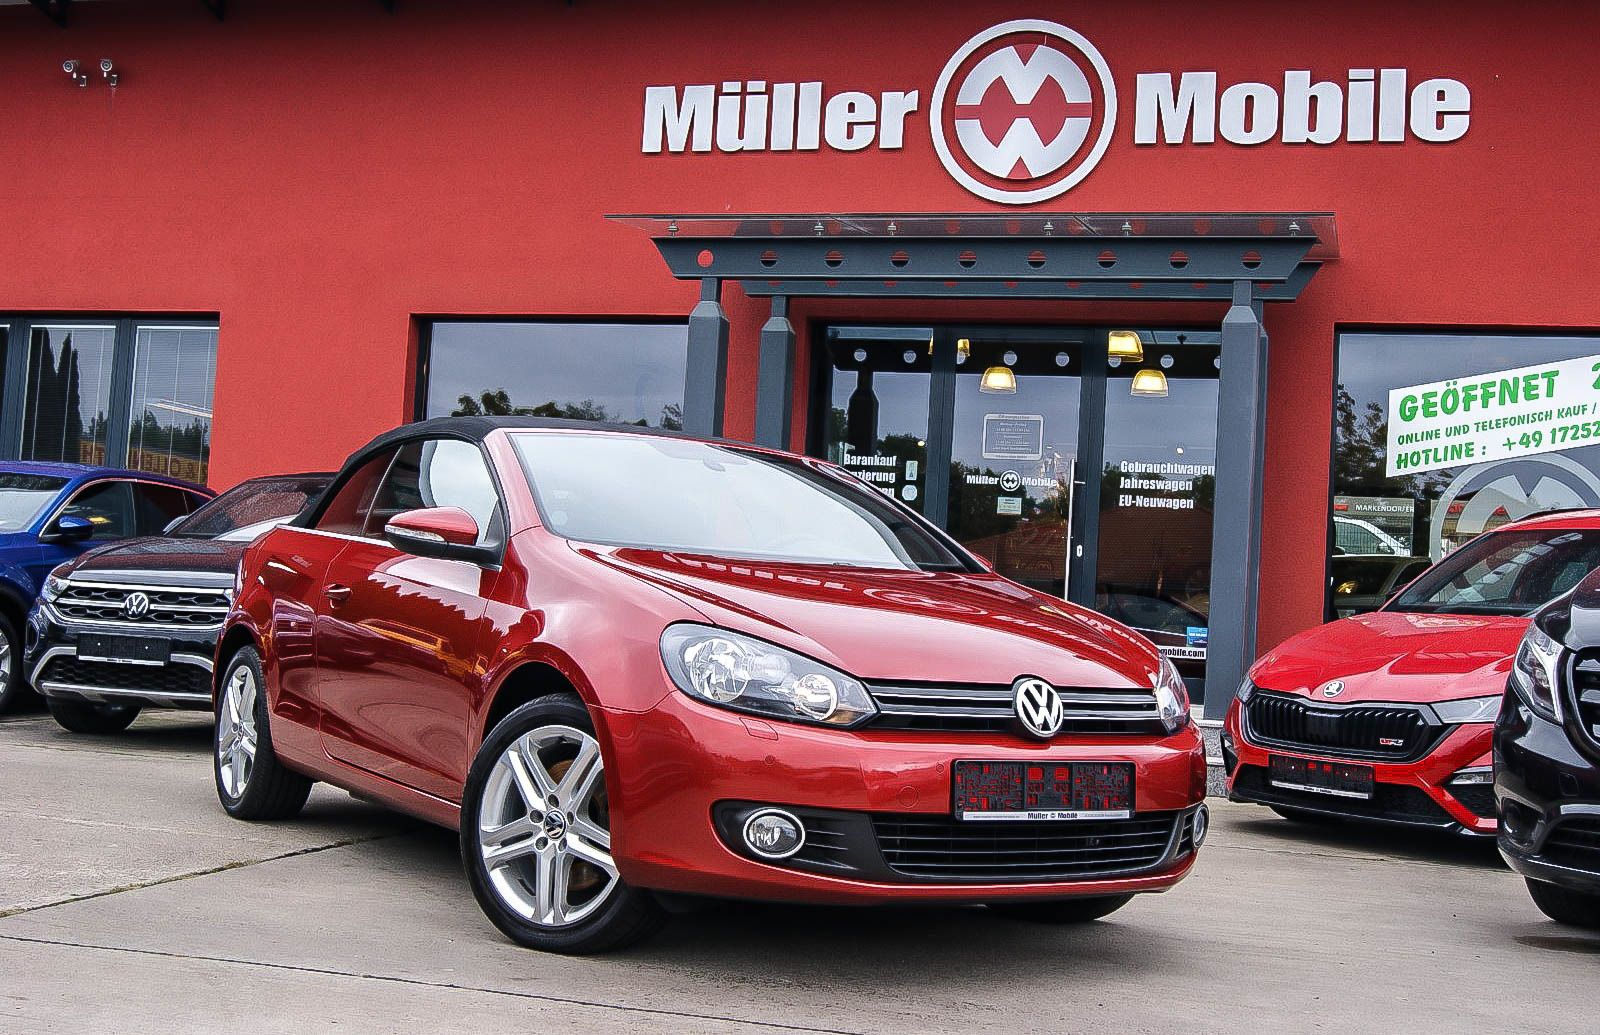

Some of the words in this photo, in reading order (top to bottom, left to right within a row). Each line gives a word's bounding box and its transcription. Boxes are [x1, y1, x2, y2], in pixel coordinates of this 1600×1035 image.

[642, 80, 919, 153] Müller
[1134, 68, 1472, 145] Mobile
[1399, 370, 1559, 422] GEÖFFNET
[1397, 428, 1441, 446] ONLINE
[1445, 424, 1470, 438] UND
[1474, 410, 1553, 433] TELEFONISCH
[1557, 404, 1588, 419] KAUF
[1396, 442, 1475, 470] HOTLINE
[1502, 430, 1543, 451] +49
[1550, 420, 1600, 445] 17252
[844, 453, 897, 467] Barankauf
[1120, 460, 1215, 476] Gebrauchtwagen
[1022, 476, 1057, 487] Mobile
[1119, 476, 1193, 492] Jahreswagen
[1118, 494, 1194, 510] EU-Neuwagen
